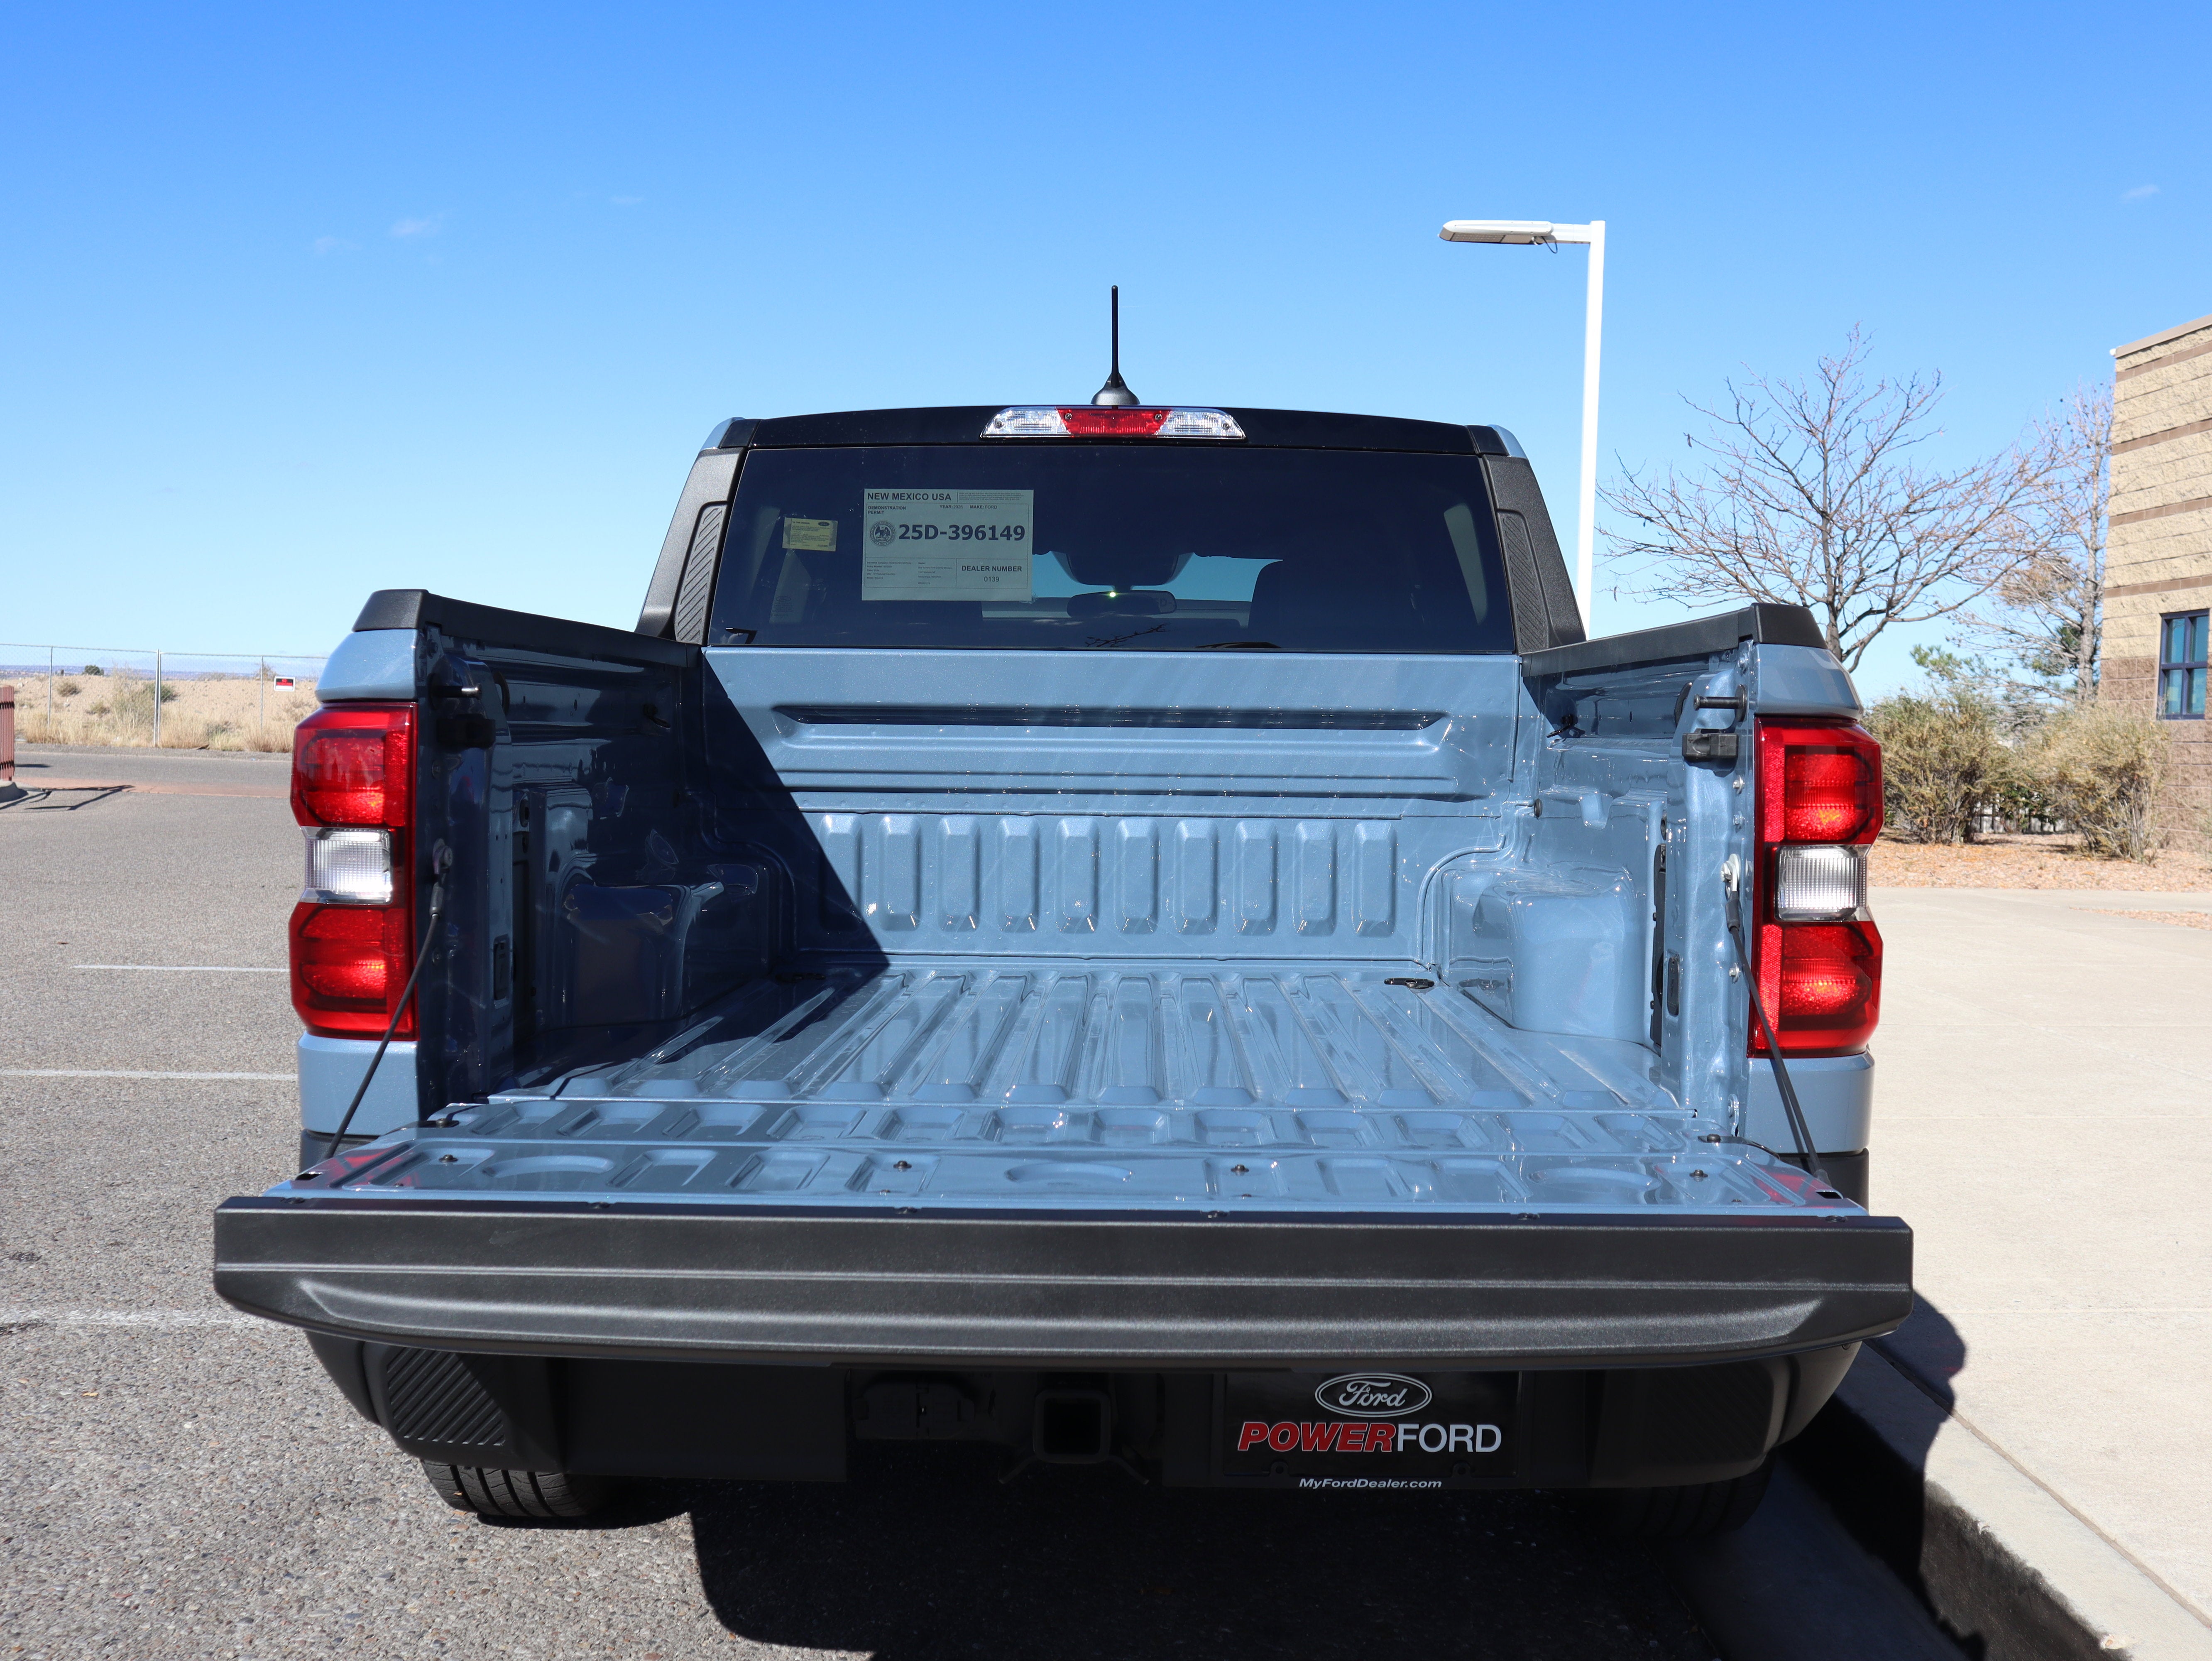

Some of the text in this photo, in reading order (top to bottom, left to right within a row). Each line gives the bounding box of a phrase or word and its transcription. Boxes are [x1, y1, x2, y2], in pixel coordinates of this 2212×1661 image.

[898, 524, 1025, 541] 25D-396149
[1338, 1381, 1408, 1407] Ford
[1299, 1478, 1442, 1489] MyFordDealer.com
